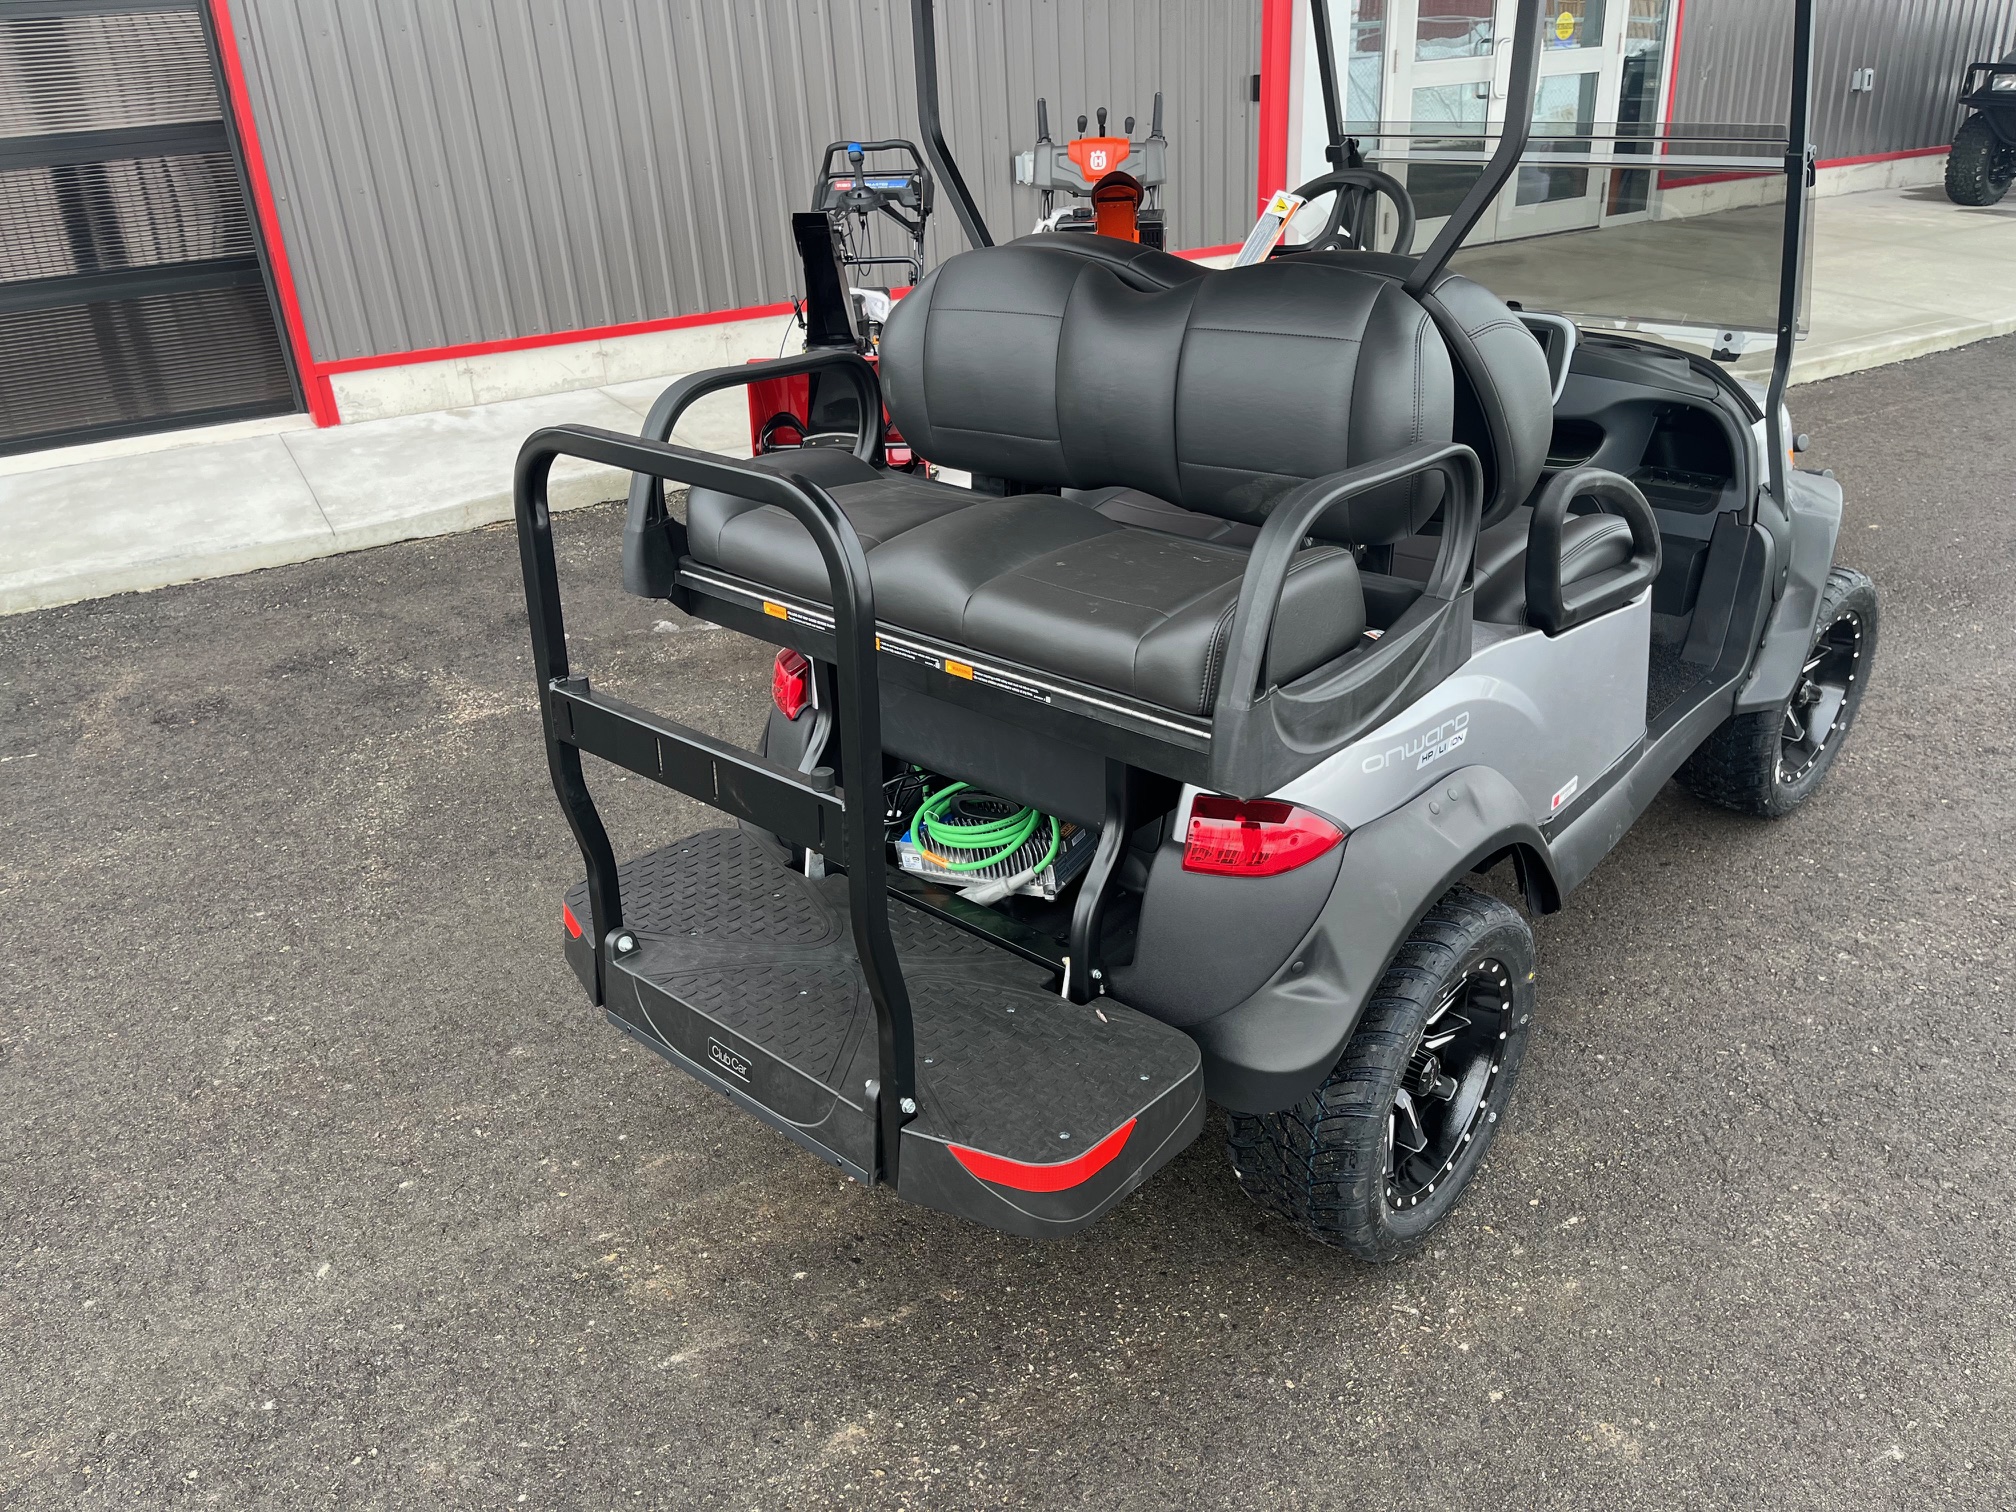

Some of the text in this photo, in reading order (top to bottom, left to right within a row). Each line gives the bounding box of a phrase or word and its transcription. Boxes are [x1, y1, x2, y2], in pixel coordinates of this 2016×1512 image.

[1421, 750, 1434, 764] HP
[711, 1045, 747, 1075] Club Car
